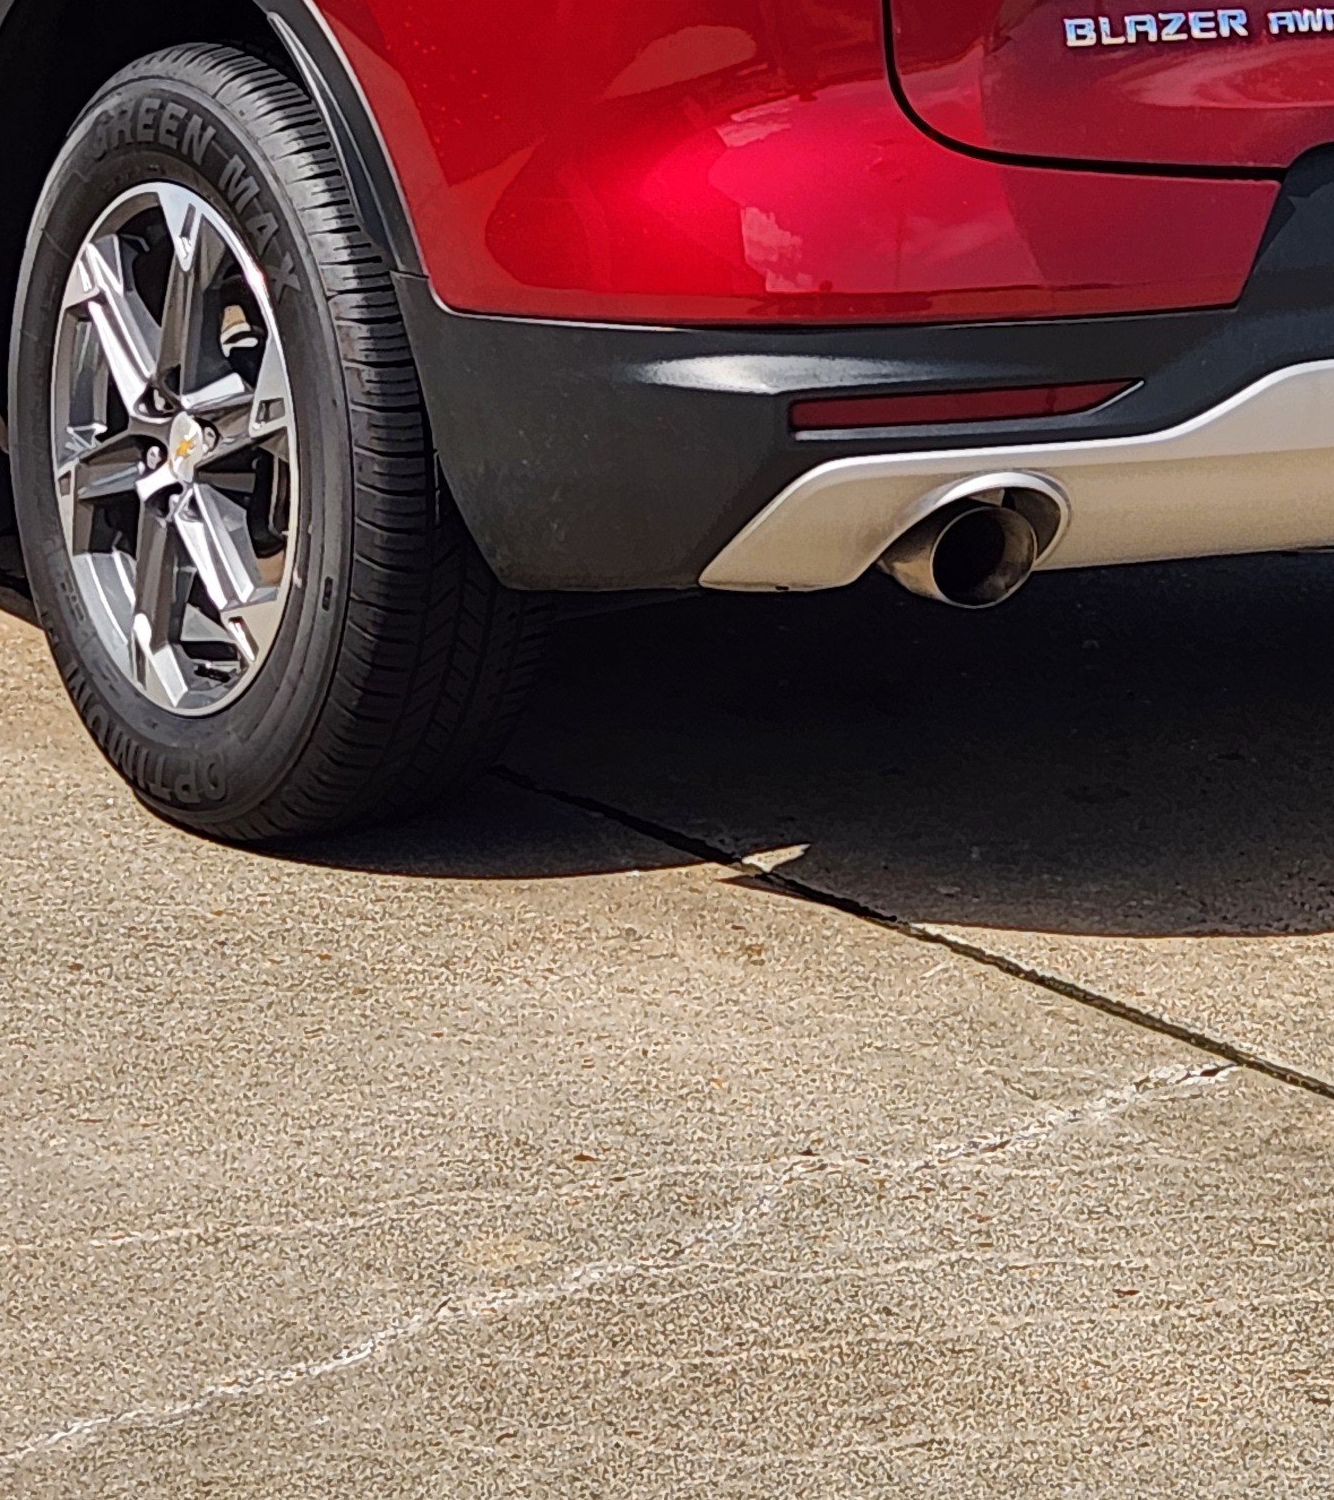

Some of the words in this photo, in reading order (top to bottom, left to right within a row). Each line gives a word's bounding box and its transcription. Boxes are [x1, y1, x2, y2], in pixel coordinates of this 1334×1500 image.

[1064, 9, 1248, 46] BLAZER
[92, 97, 217, 166] GREEN
[218, 154, 302, 305] MAX
